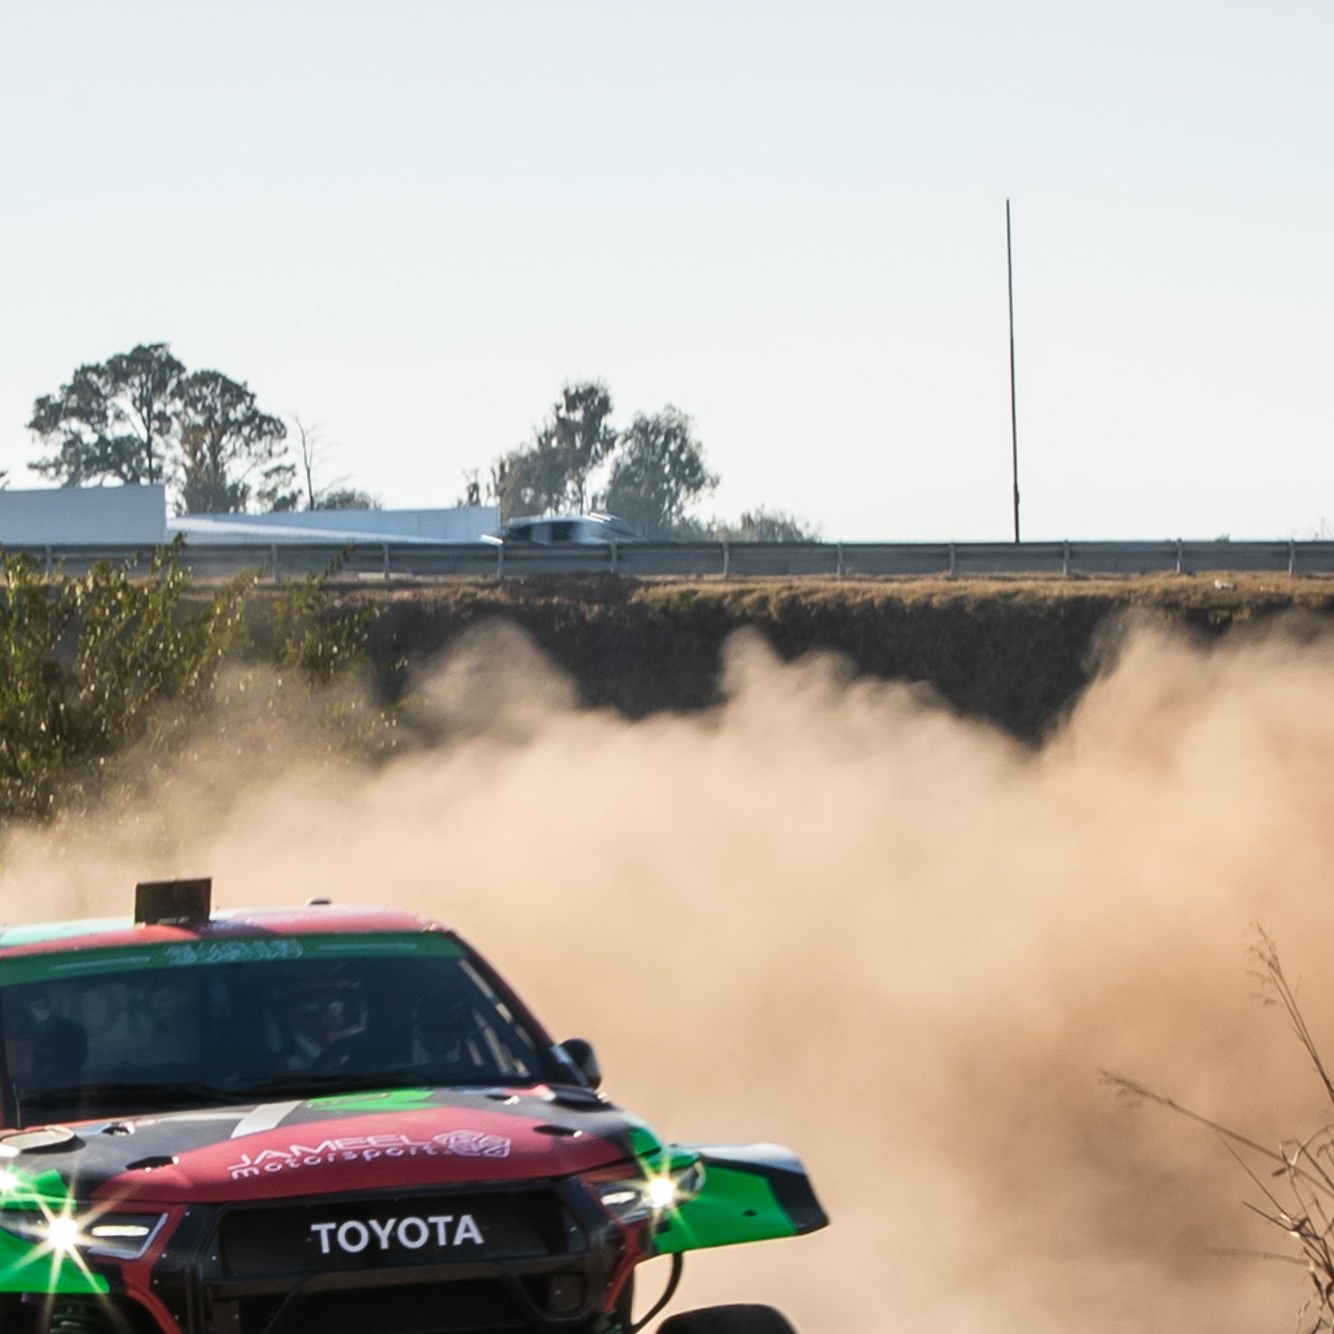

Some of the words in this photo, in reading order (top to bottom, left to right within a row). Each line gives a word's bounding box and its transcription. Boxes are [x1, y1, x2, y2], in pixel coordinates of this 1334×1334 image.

[227, 1134, 433, 1170] JAMEEL
[231, 1144, 440, 1180] motorsport
[310, 1214, 485, 1254] TOYOTA
